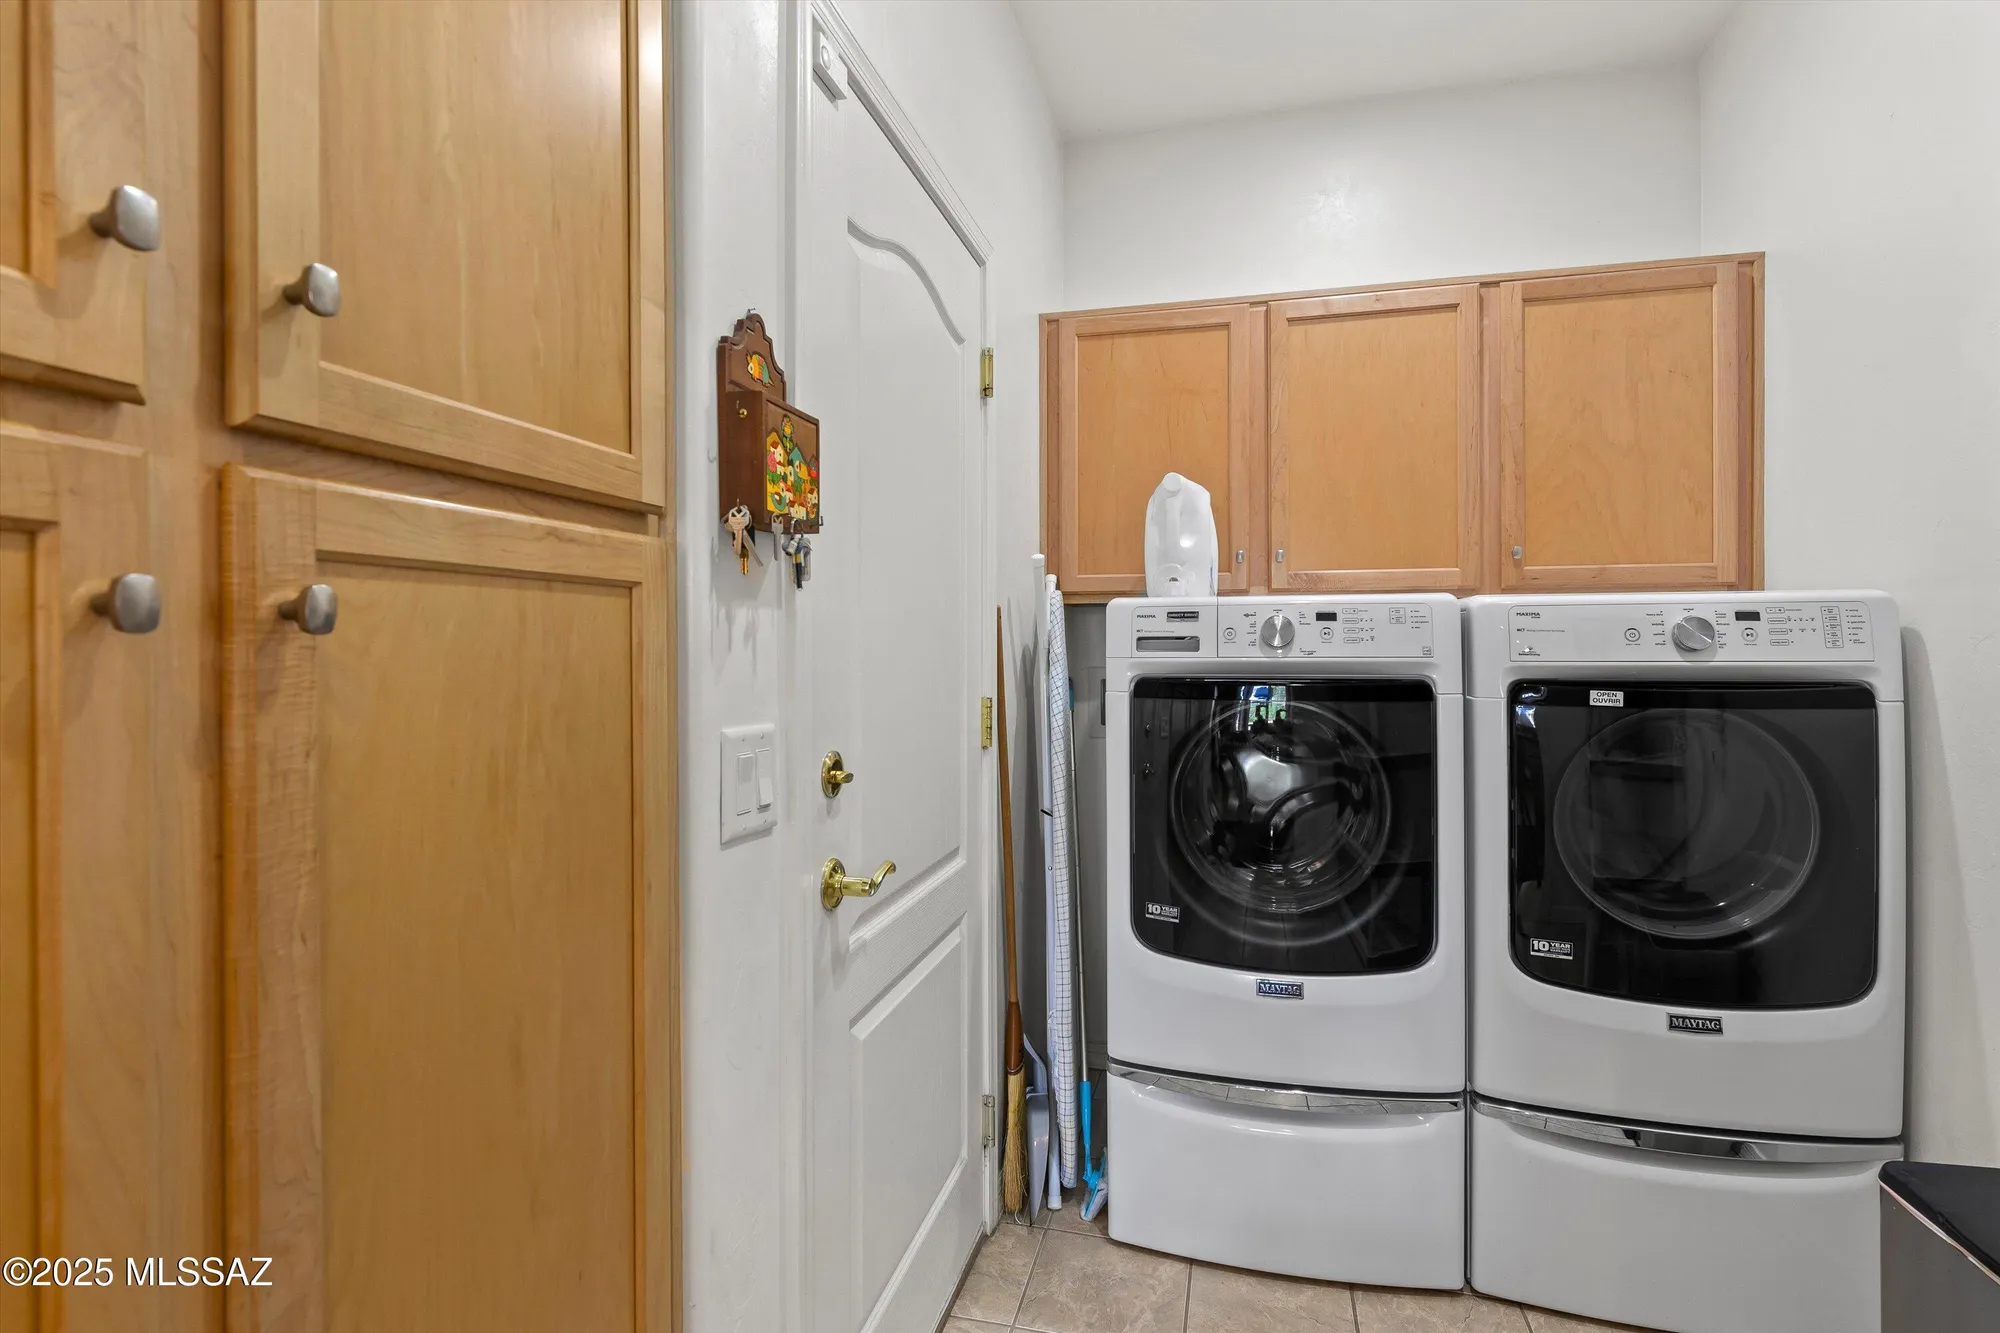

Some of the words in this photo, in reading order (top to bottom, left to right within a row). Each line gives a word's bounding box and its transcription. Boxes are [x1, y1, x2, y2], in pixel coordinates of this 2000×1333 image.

[1148, 904, 1160, 914] 10
[1532, 940, 1550, 951] 10
[1260, 984, 1300, 994] MAYTAG
[1672, 1018, 1720, 1030] MAYTAG
